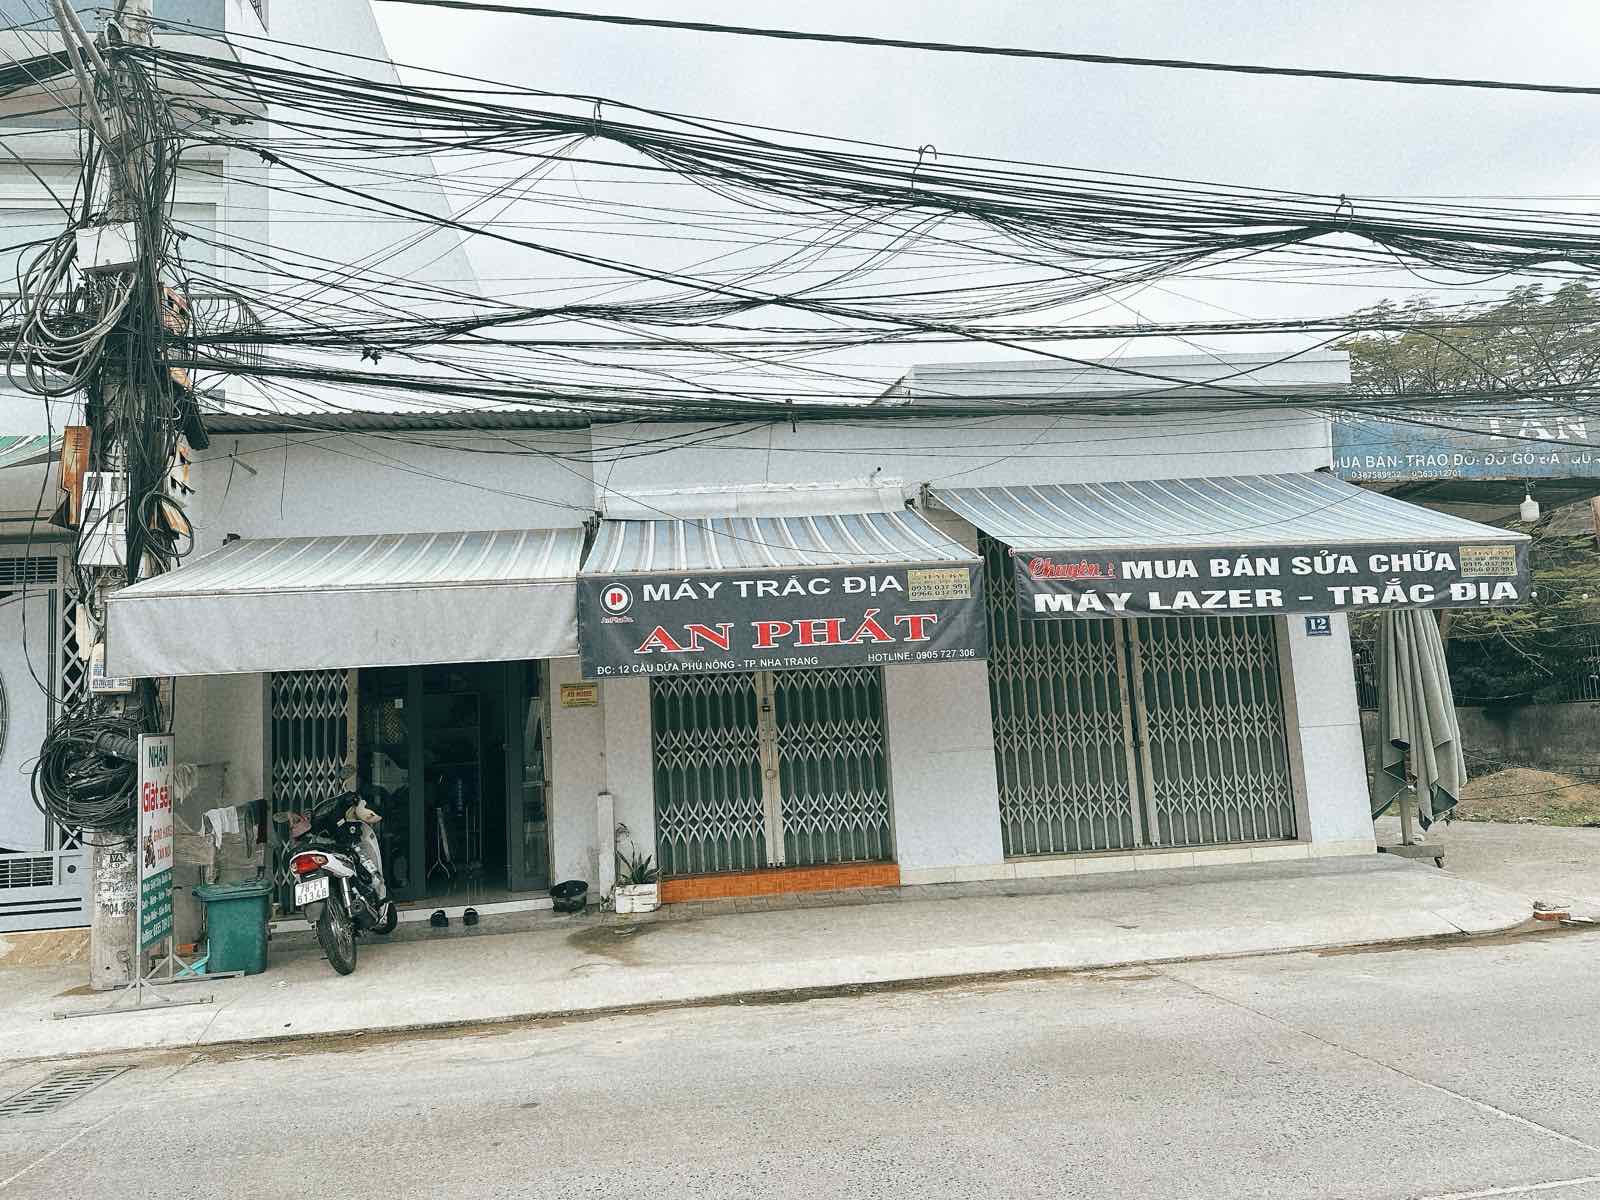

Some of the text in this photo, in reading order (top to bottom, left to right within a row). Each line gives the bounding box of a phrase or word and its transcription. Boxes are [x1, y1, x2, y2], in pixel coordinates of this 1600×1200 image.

[1121, 559, 1199, 580] MUA
[1209, 553, 1280, 578] BÁN
[1291, 549, 1359, 576] SỬA
[1368, 549, 1456, 573] CHỮA
[643, 575, 904, 602] MÁY TRẮC ĐỊA
[1034, 589, 1133, 613] MÁY
[1149, 588, 1284, 611] LAZER
[1327, 577, 1435, 605] TRẮC
[1450, 581, 1519, 605] ĐỊA
[633, 608, 938, 655] AN PHÁT
[1311, 617, 1327, 630] 12
[597, 666, 616, 675] ĐC:
[619, 665, 630, 674] 12
[760, 657, 782, 667] NHA
[783, 656, 819, 666] TRANG
[868, 652, 914, 662] HOTLINE:
[916, 650, 939, 660] 0905
[940, 649, 957, 658] 727
